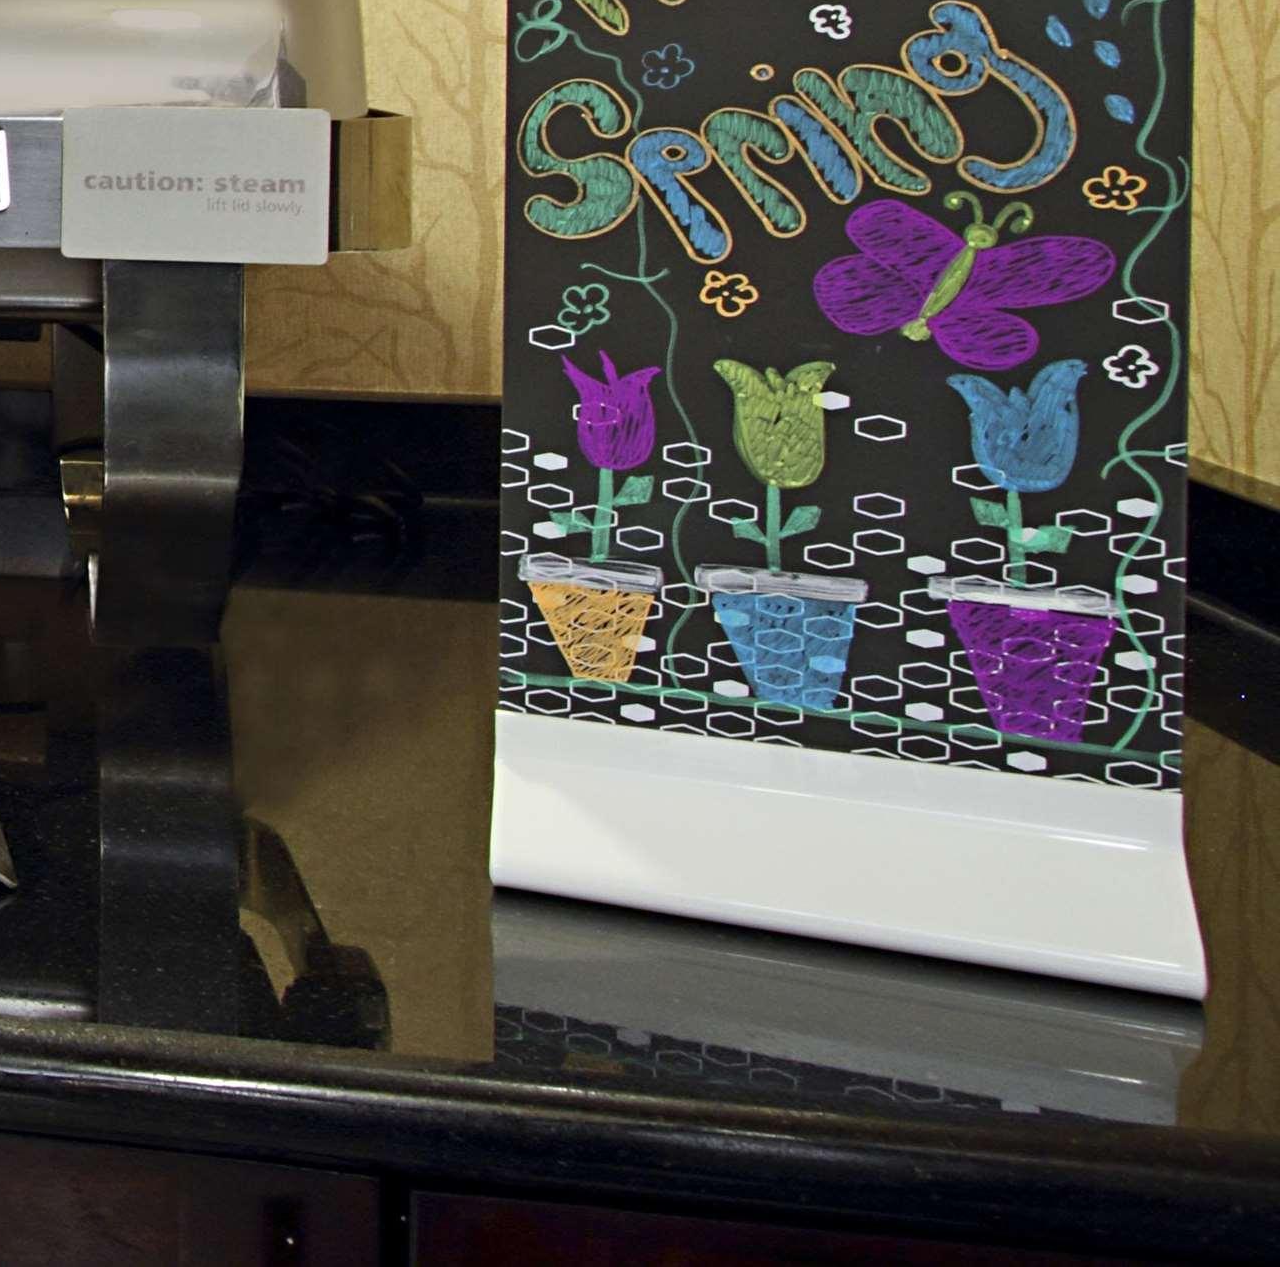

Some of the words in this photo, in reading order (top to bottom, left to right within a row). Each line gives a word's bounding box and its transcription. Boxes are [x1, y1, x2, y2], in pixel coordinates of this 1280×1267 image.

[83, 171, 204, 192] caution:
[214, 174, 306, 194] steam
[206, 197, 227, 212] lift
[232, 197, 251, 213] lid
[255, 198, 305, 216] slowly.
